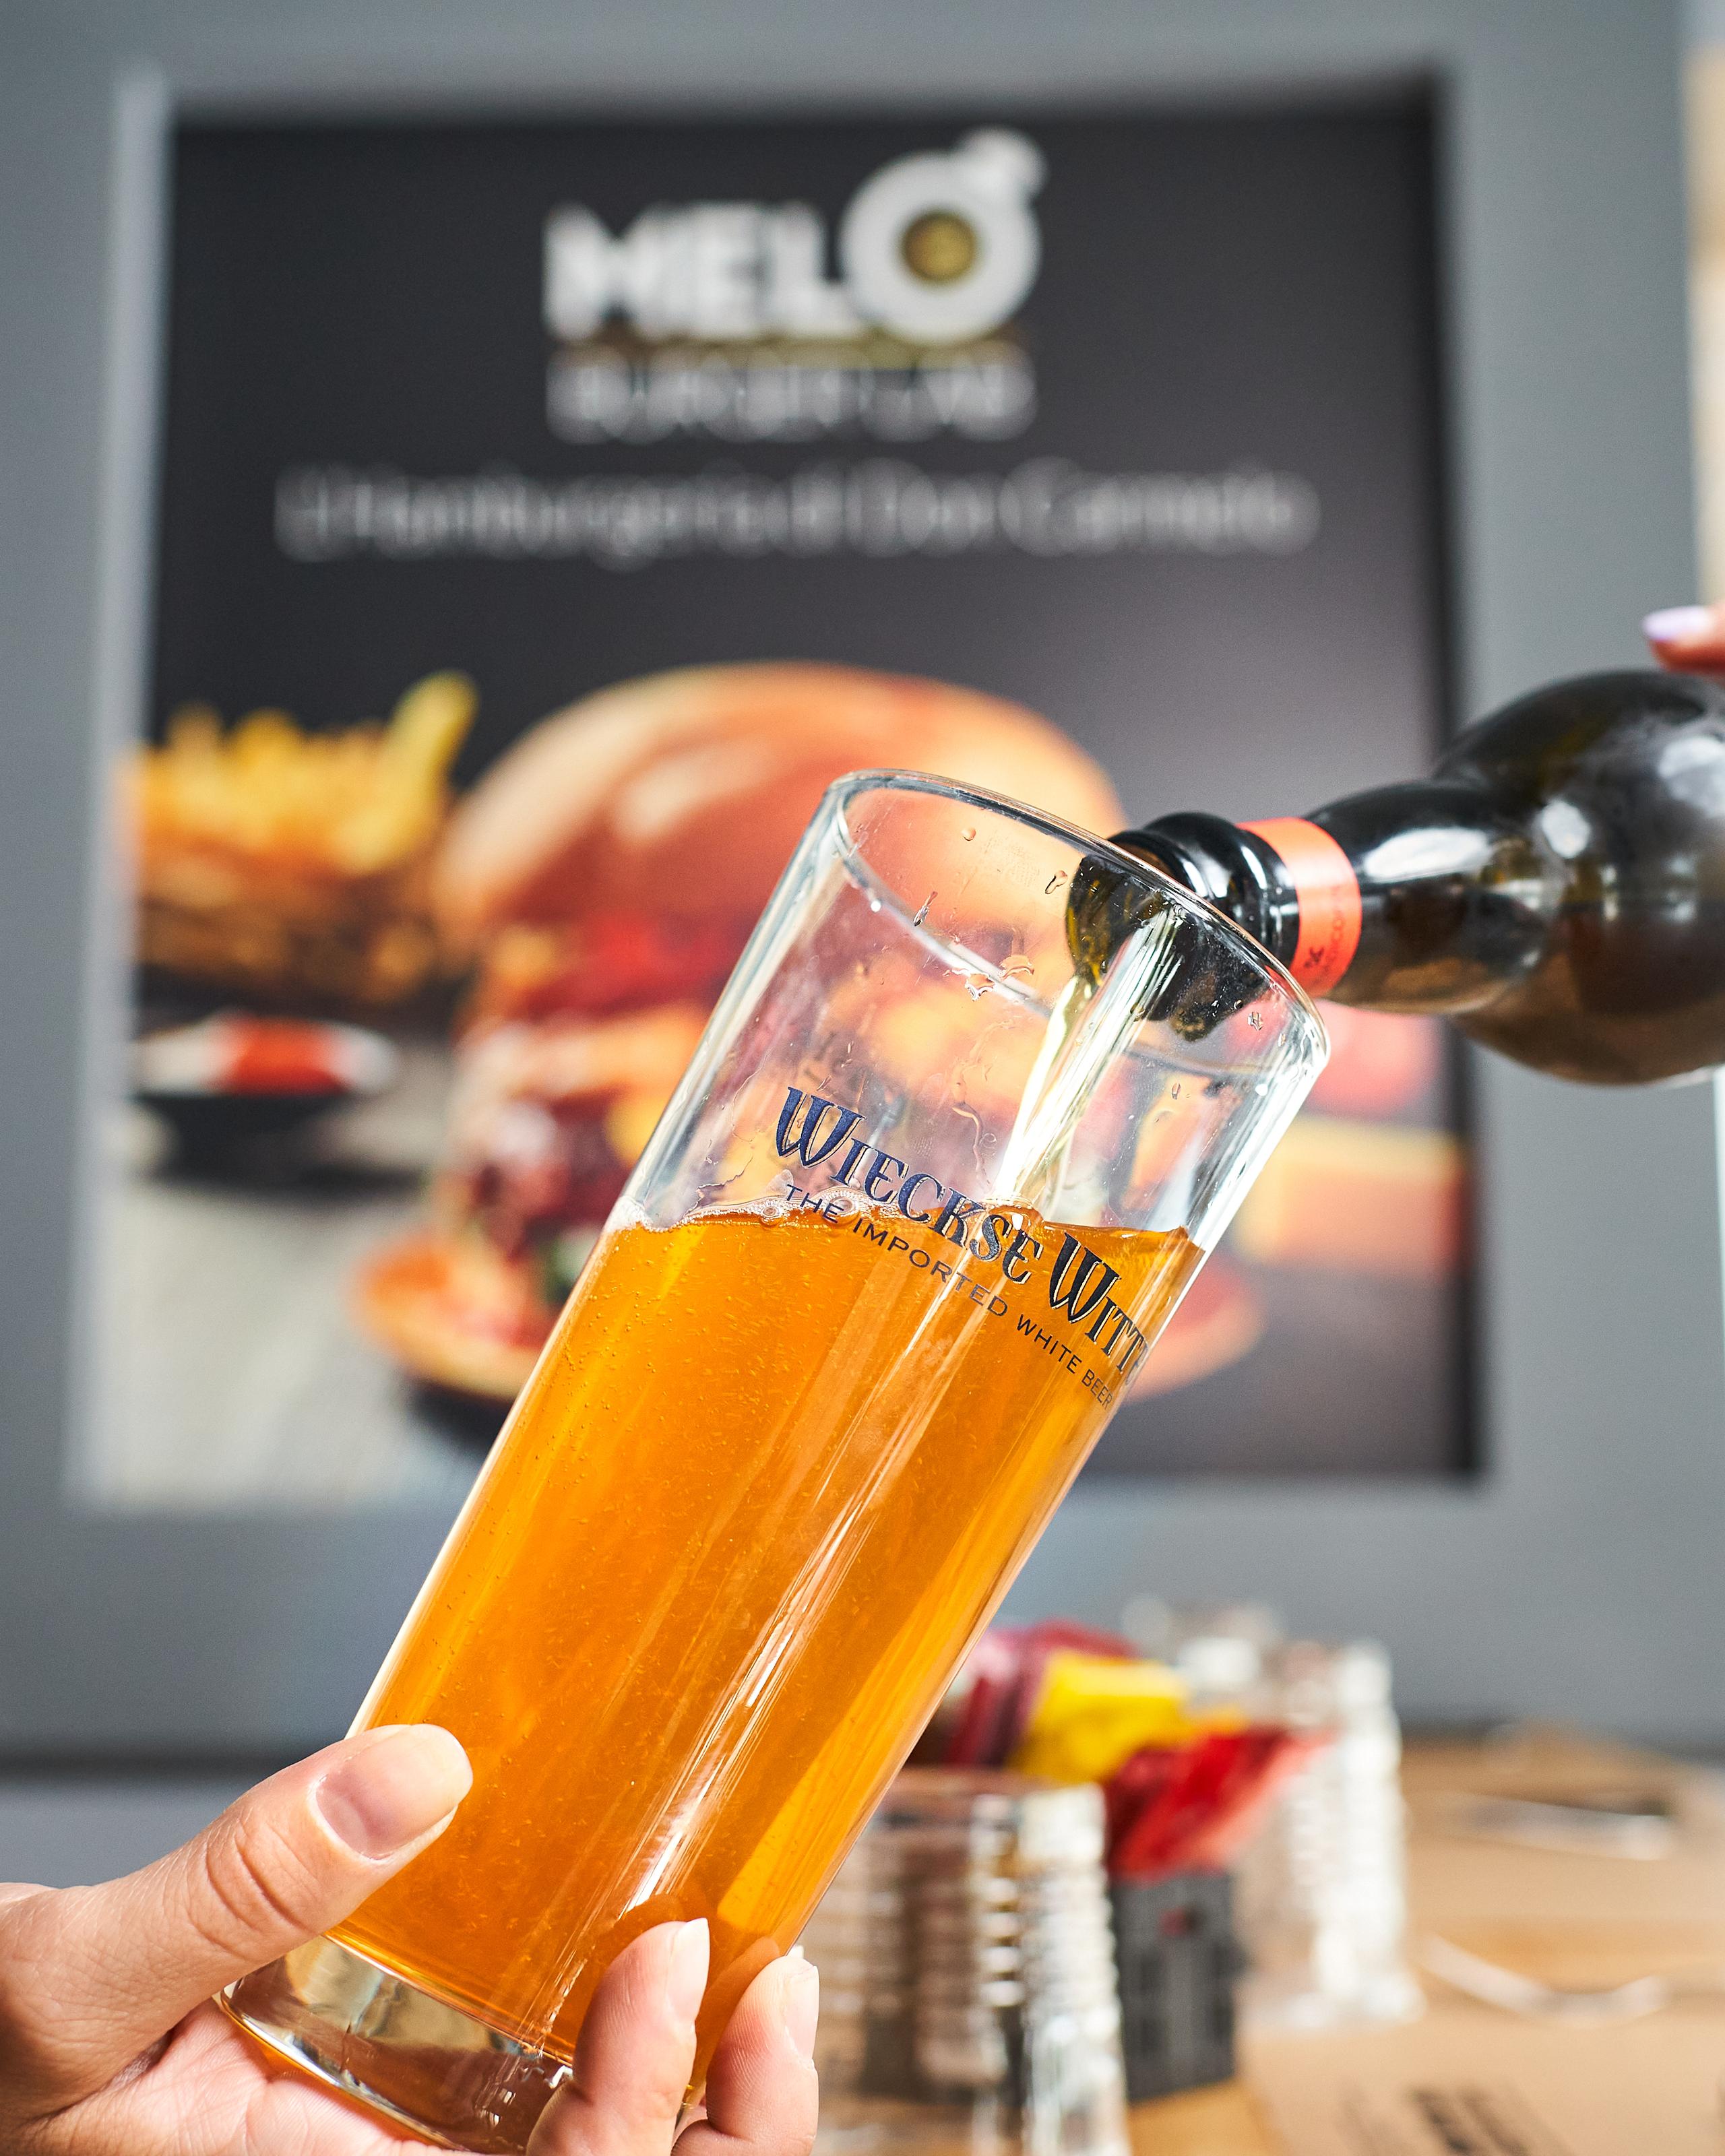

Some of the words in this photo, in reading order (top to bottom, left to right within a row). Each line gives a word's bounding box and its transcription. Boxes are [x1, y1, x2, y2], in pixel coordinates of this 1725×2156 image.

[850, 459, 1007, 557] Don
[775, 1086, 1044, 1285] WIECKSE
[1048, 1232, 1149, 1384] WITT
[786, 1184, 844, 1223] THE
[853, 1220, 1008, 1317] IMPORTED
[1016, 1314, 1082, 1374] WHITE
[1081, 1368, 1114, 1409] BEER
